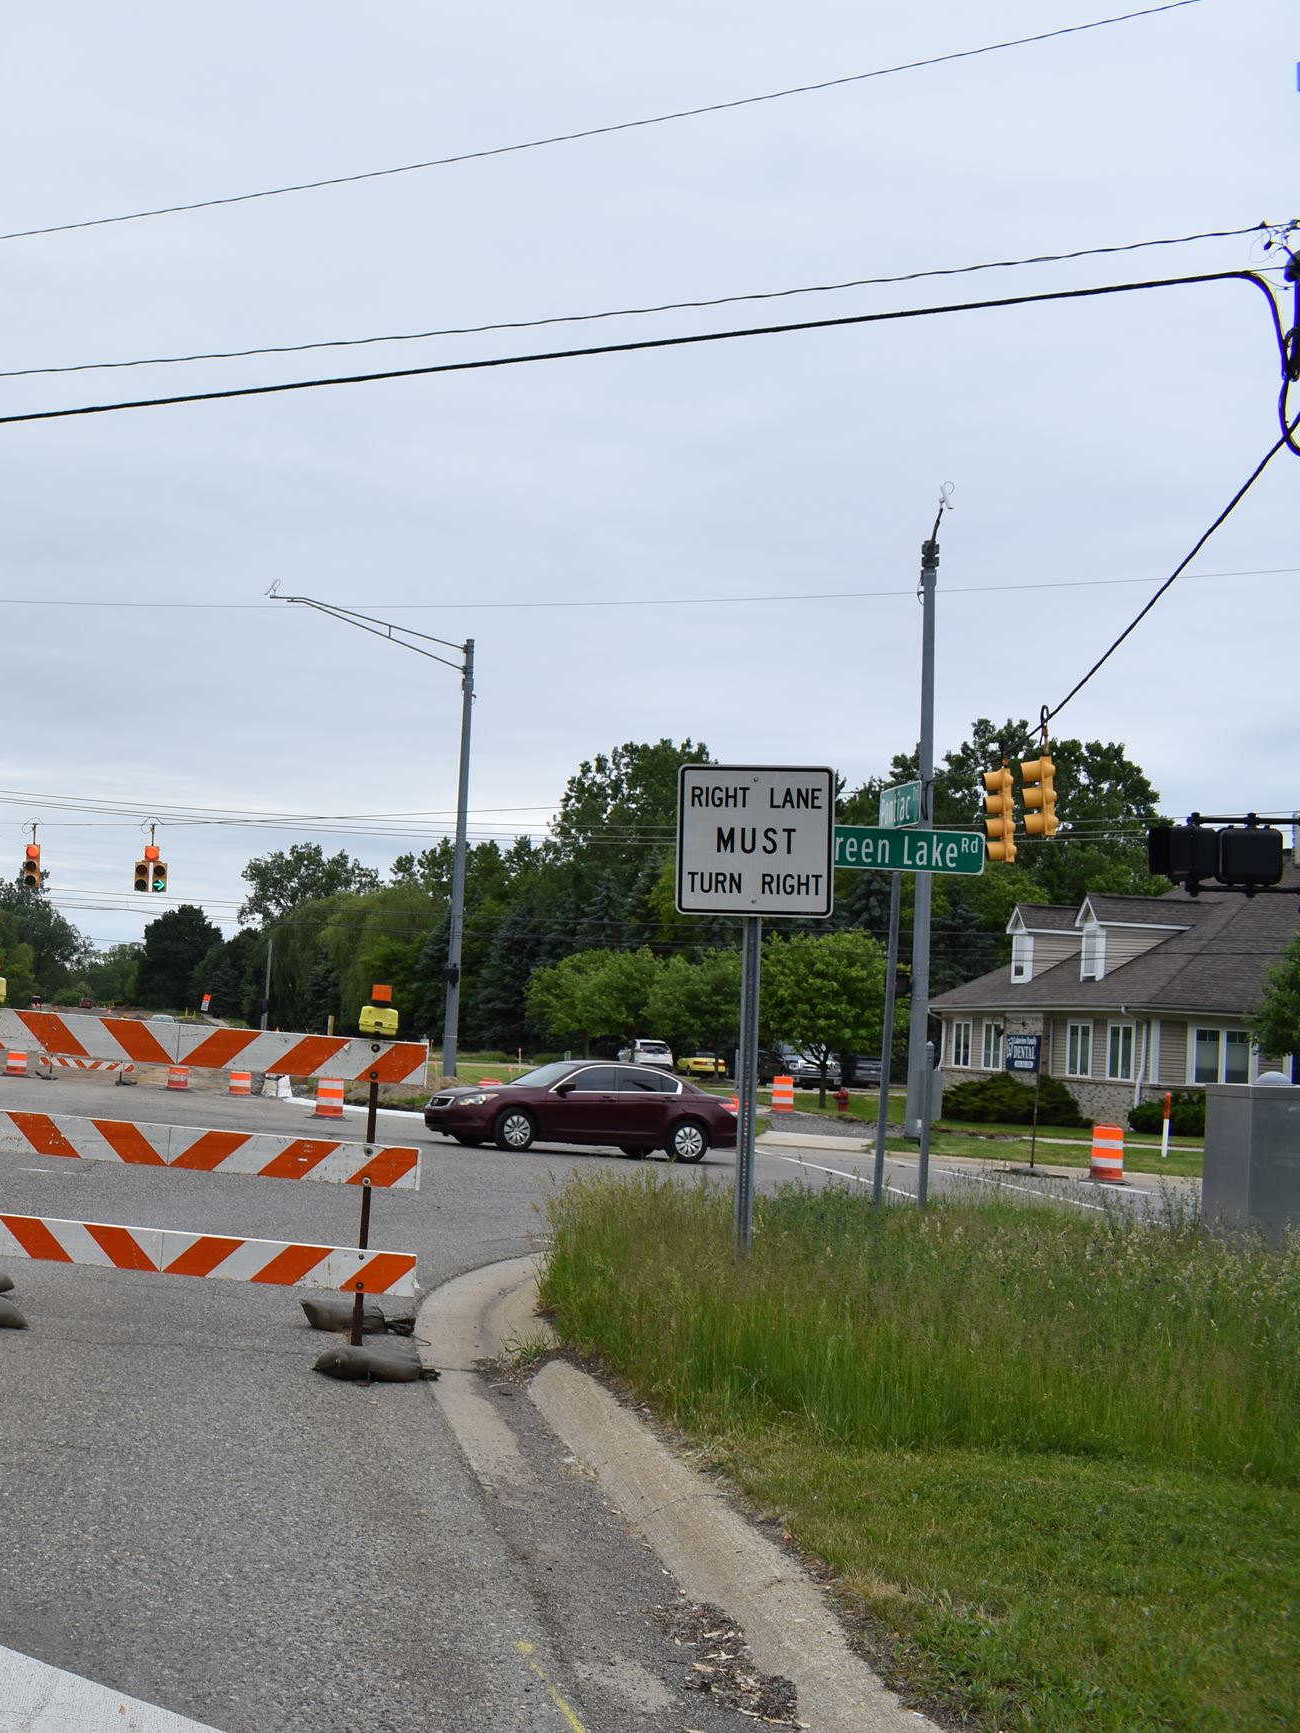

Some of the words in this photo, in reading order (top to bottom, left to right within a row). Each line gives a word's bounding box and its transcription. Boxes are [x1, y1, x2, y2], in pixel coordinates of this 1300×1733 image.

[691, 786, 750, 808] RIGHT
[770, 787, 822, 809] LANE
[882, 790, 910, 825] Pontiac
[716, 827, 796, 854] MUST
[835, 836, 890, 864] reen
[903, 835, 958, 868] Lake
[961, 837, 979, 853] Rd
[688, 872, 742, 894] TURN
[761, 873, 822, 896] RIGHT
[1013, 1045, 1036, 1060] DENTAL
